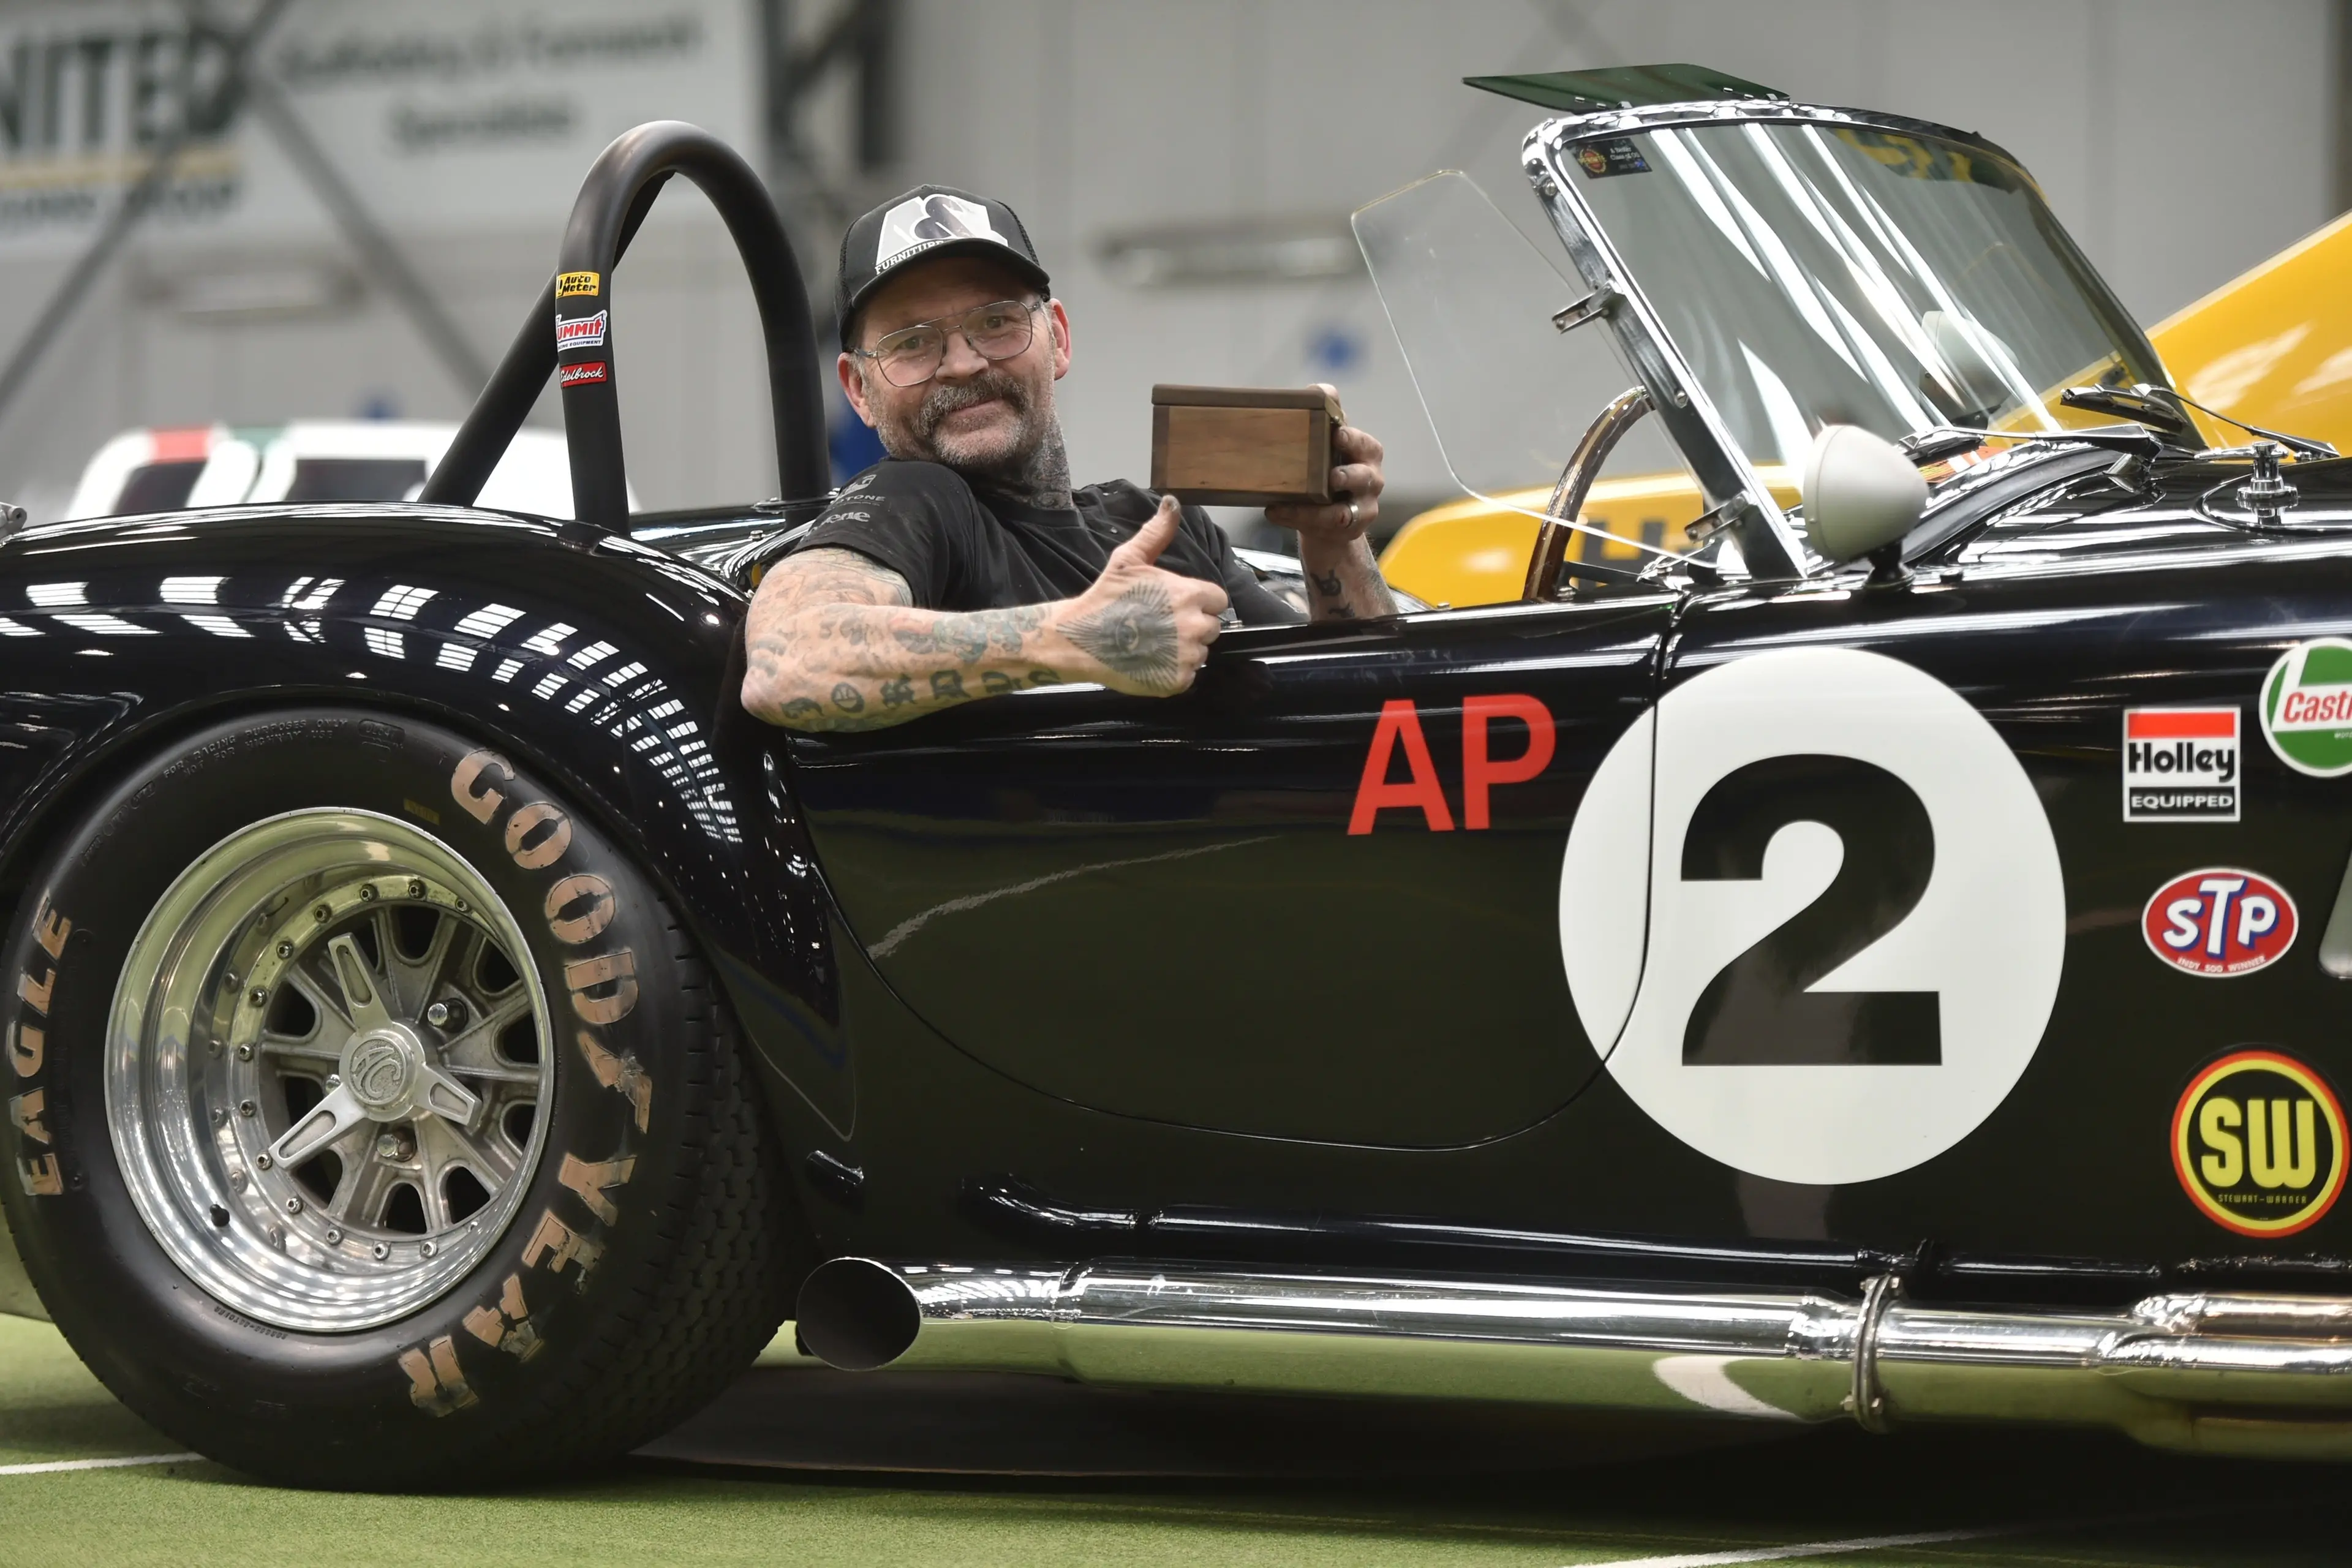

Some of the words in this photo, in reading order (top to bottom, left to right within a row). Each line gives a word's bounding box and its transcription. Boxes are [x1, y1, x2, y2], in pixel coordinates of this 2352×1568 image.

[562, 284, 597, 293] Meter
[564, 275, 591, 285] Auto
[557, 318, 602, 341] UMMIT
[560, 365, 604, 383] Edelbrock
[1348, 693, 1555, 835] AP
[2128, 741, 2235, 783] Holley
[2131, 794, 2234, 809] EQUIPPED
[1680, 753, 1942, 1066] 2
[2163, 879, 2278, 957] STP
[2176, 956, 2201, 970] INDY
[2204, 963, 2223, 973] 500
[2227, 954, 2266, 972] WINNER
[6, 888, 72, 1196] EAGLE
[2199, 1097, 2316, 1188] SW
